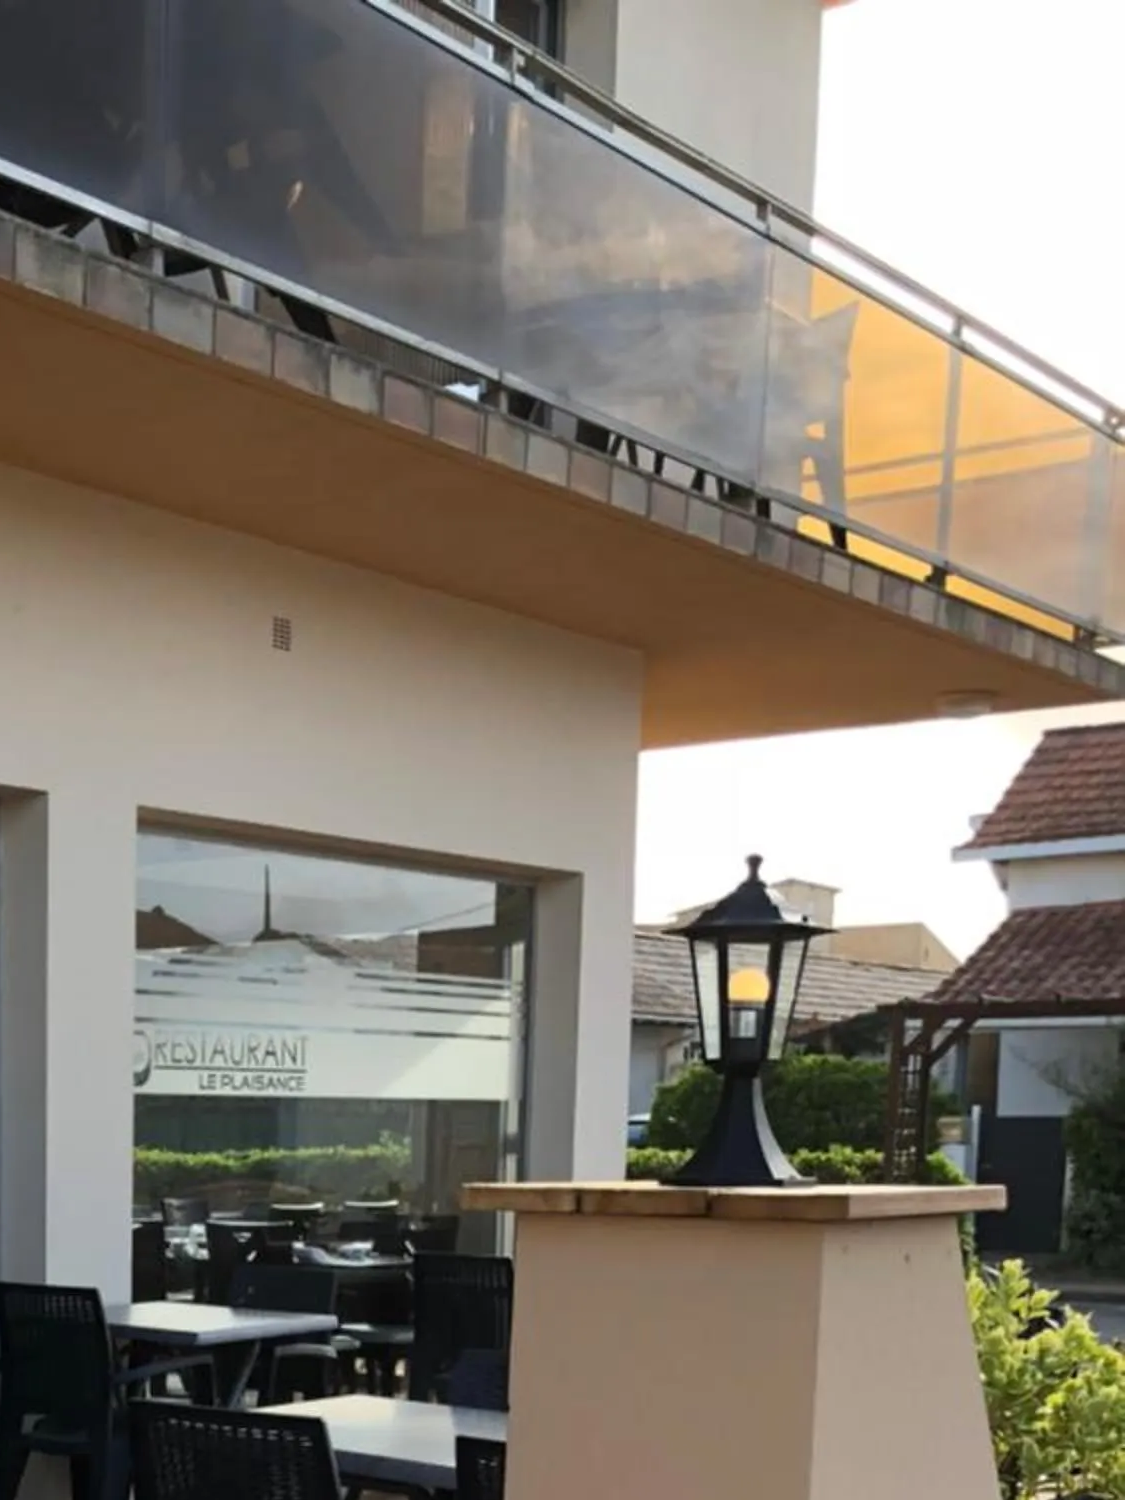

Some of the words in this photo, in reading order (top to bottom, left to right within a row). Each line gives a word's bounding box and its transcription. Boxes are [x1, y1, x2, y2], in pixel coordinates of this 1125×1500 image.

[153, 1032, 308, 1067] RESTAURANT
[198, 1074, 217, 1091] LE
[220, 1074, 306, 1092] PLAISANCE
